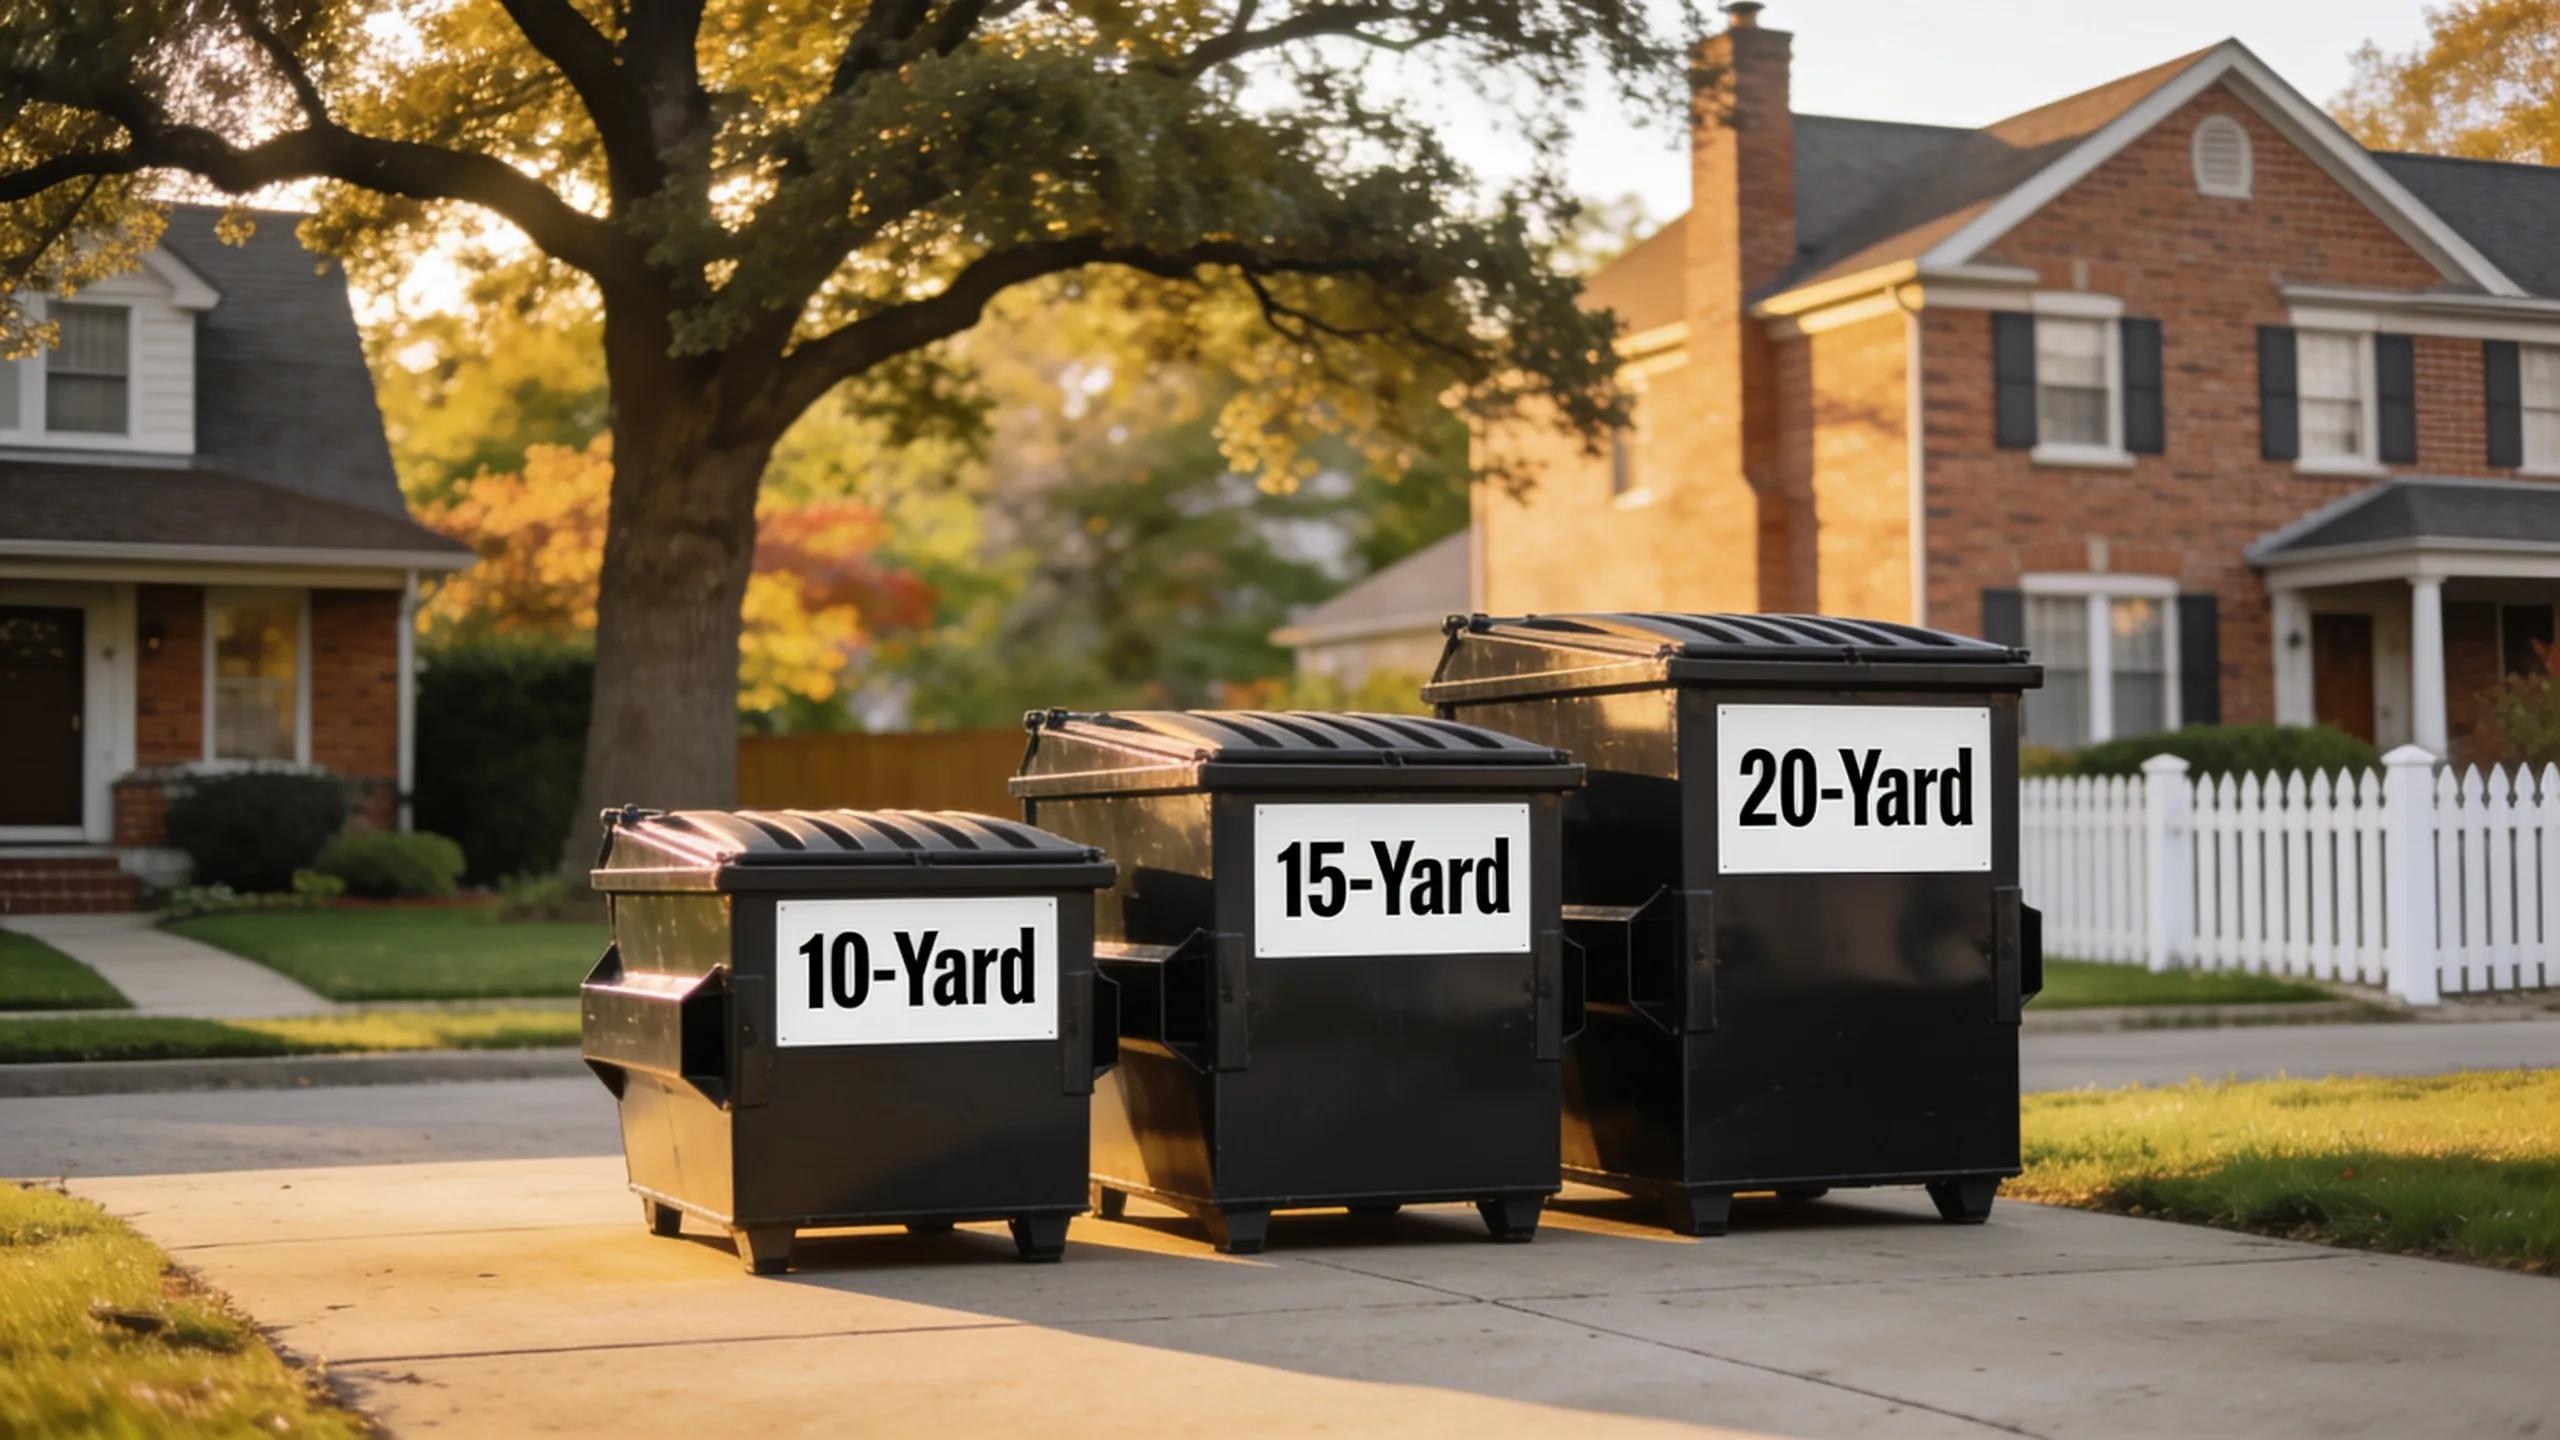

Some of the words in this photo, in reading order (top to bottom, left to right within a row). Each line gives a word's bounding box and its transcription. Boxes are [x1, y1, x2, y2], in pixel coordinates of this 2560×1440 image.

[1739, 747, 1973, 828] 20-Yard
[1277, 837, 1511, 918] 15-Yard
[799, 926, 1036, 1009] 10-Yard
